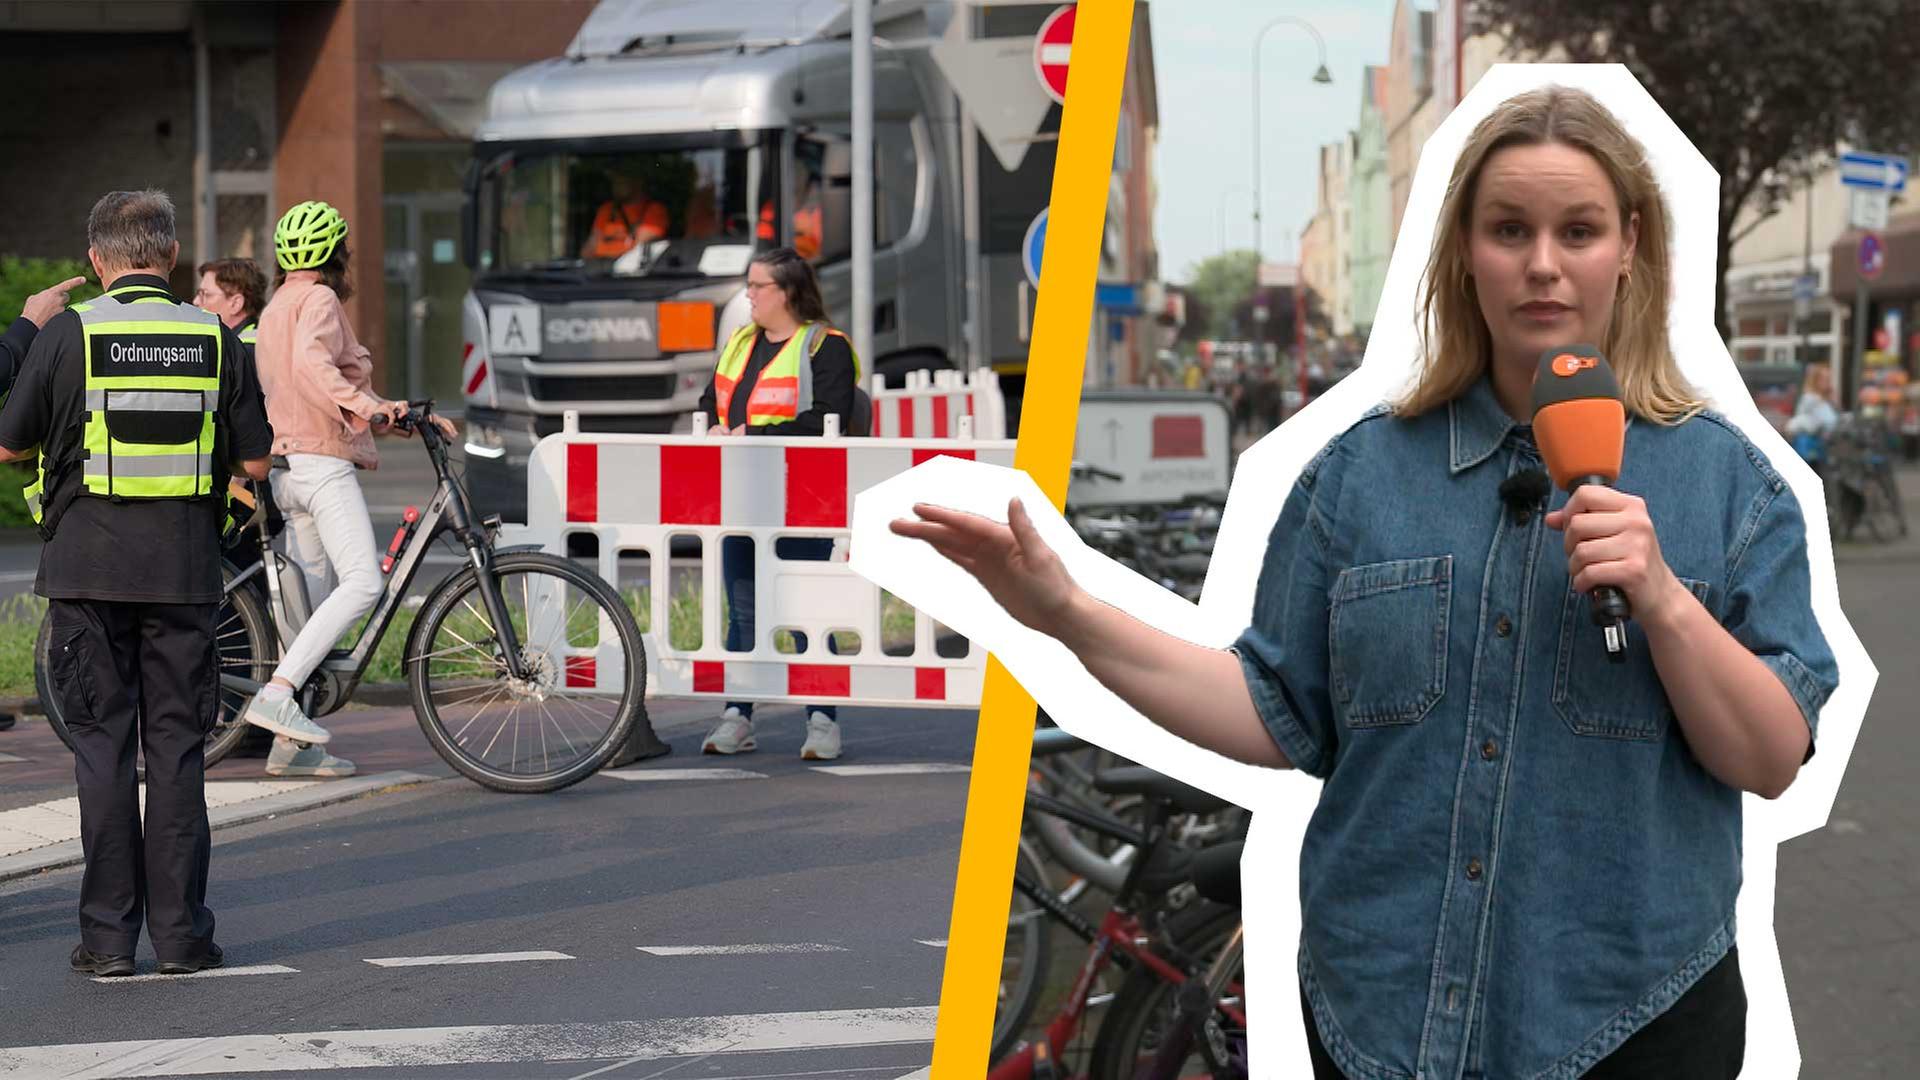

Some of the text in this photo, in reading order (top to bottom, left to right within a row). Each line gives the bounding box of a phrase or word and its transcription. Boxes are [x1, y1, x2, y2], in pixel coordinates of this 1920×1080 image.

[504, 312, 527, 346] A
[546, 317, 651, 344] SCANIA
[110, 342, 203, 367] Ordnungsamt
